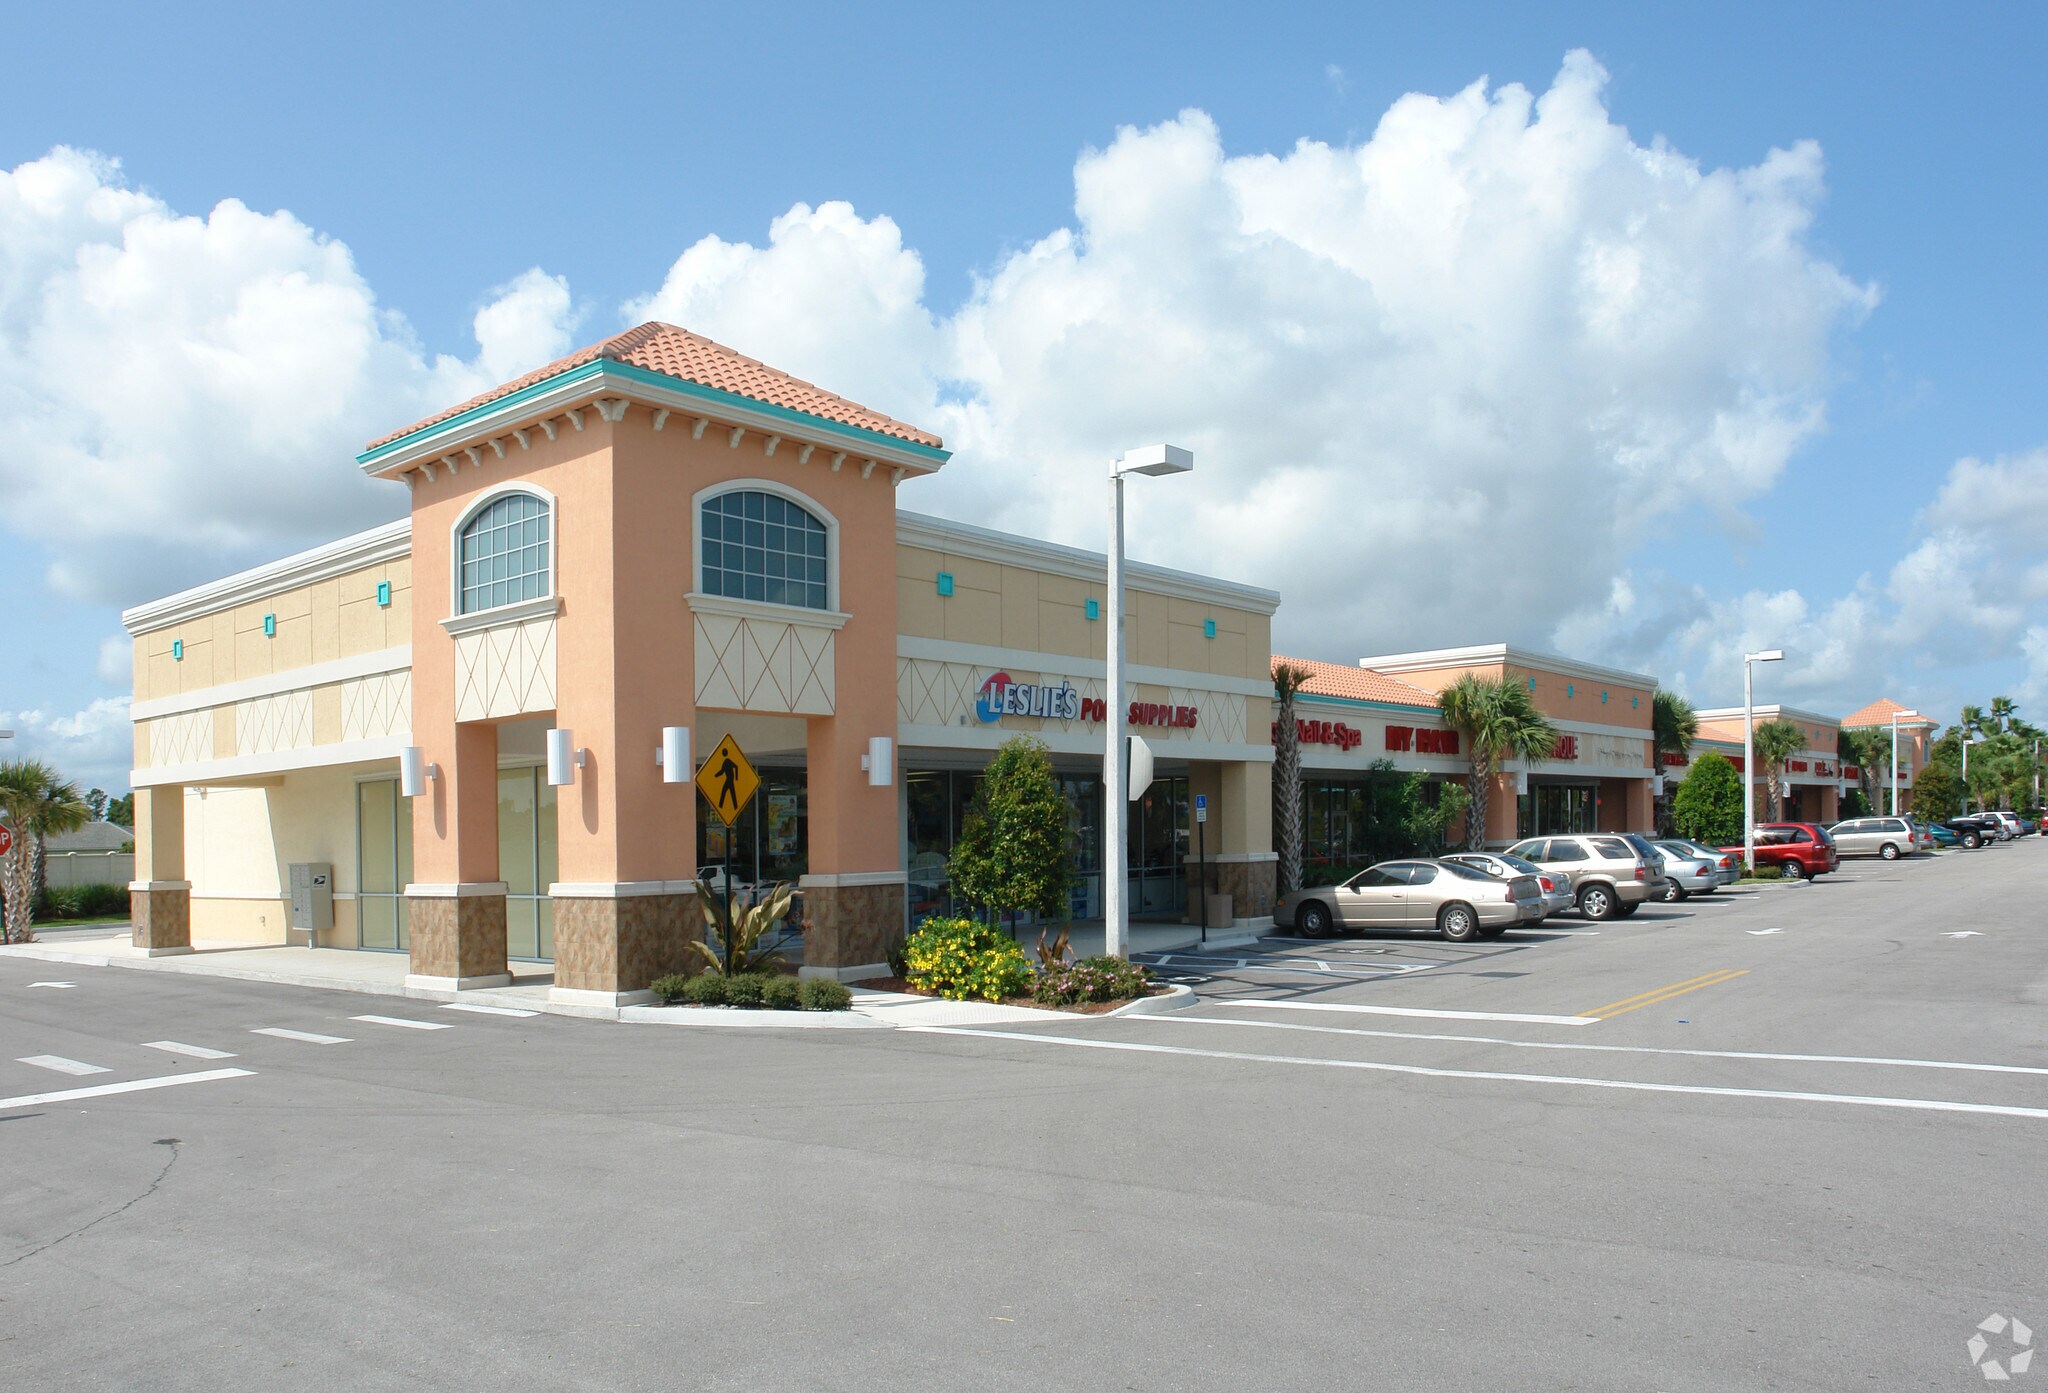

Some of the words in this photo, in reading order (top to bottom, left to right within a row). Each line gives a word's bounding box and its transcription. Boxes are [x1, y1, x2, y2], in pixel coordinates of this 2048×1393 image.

[988, 680, 1078, 719] LESLIE'S
[1080, 697, 1107, 722] PO
[1128, 701, 1198, 729] SUPPLIES
[1320, 721, 1335, 745] &
[1333, 722, 1362, 751] Spa
